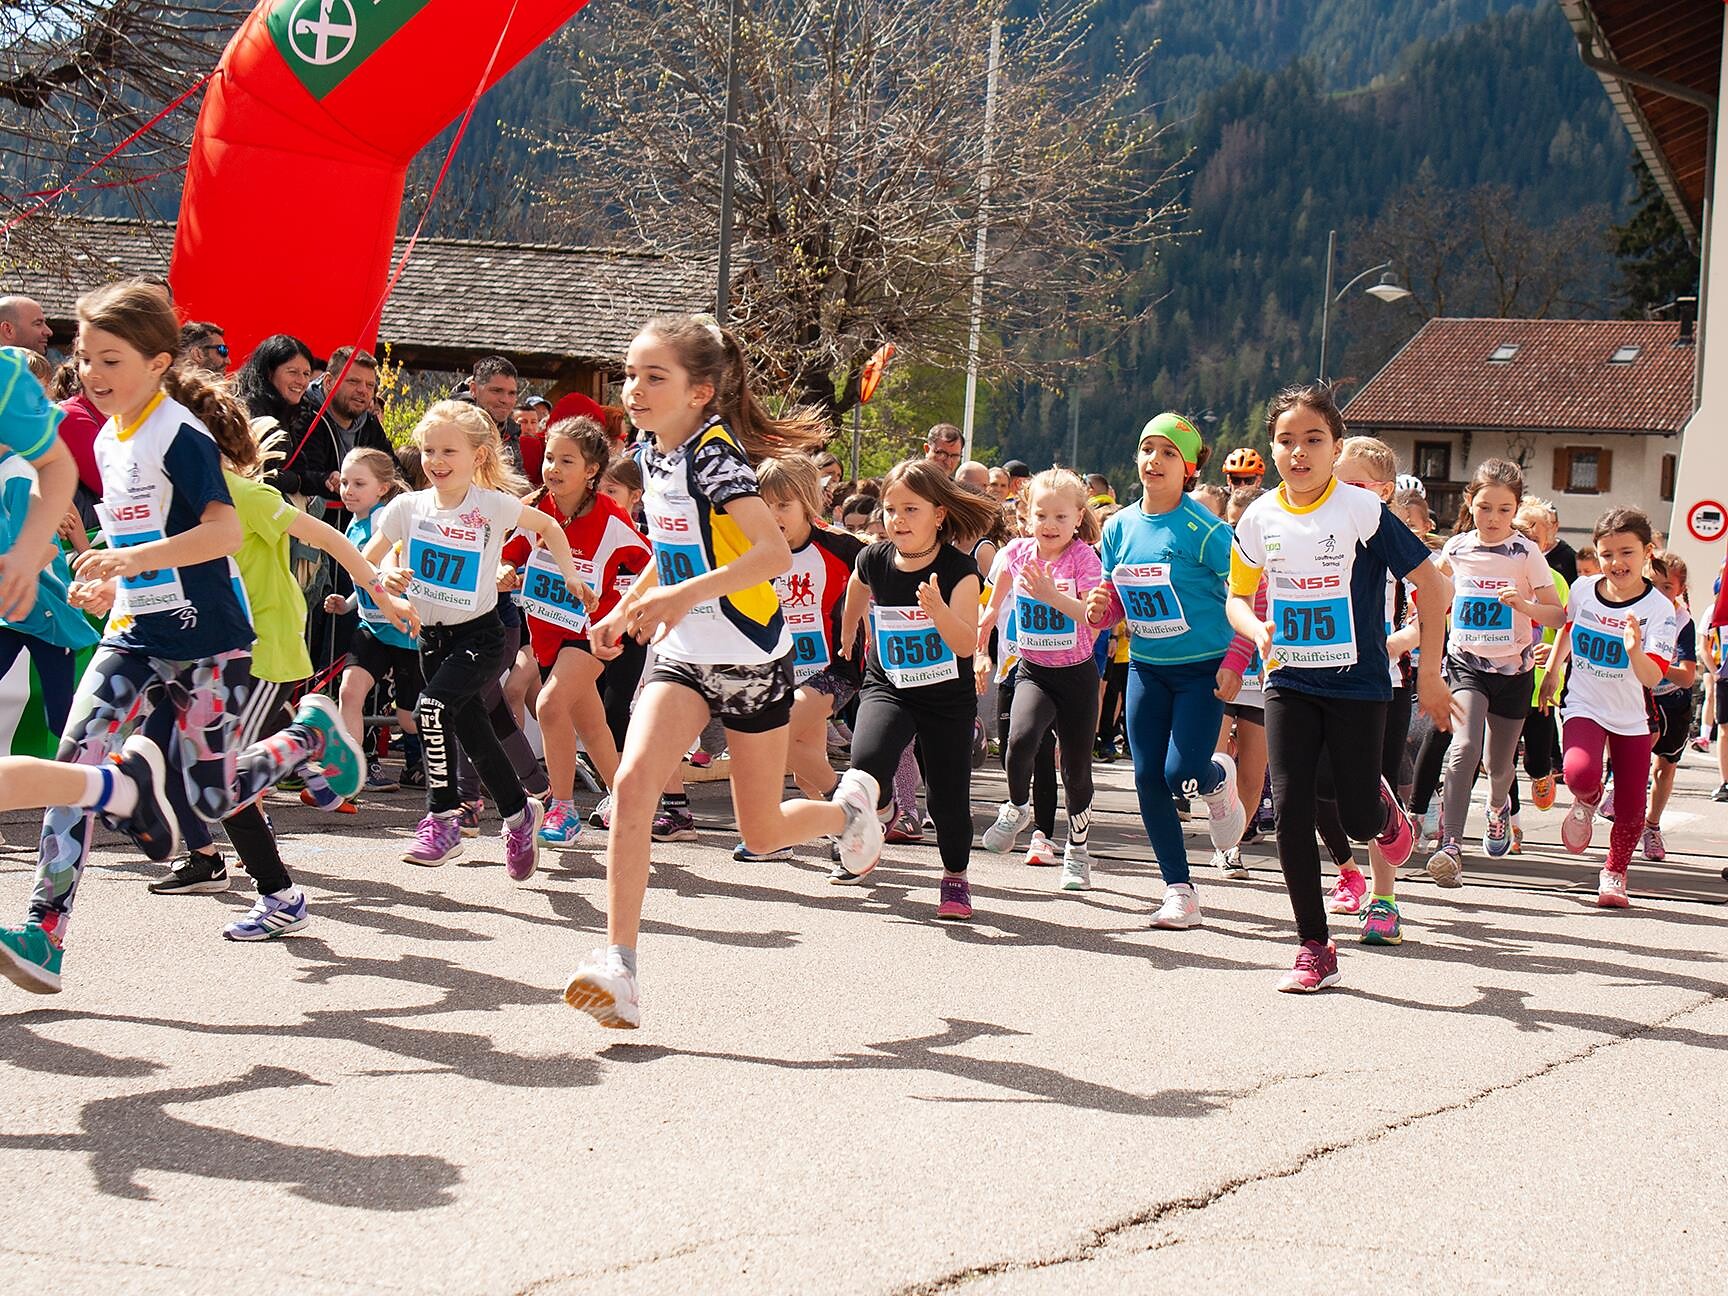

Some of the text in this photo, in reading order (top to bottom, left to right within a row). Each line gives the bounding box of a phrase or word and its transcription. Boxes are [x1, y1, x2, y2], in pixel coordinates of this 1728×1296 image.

[436, 524, 477, 541] VSS
[421, 548, 466, 585] 677
[1127, 566, 1163, 577] VSS
[1290, 575, 1340, 590] VSS
[423, 586, 472, 606] Raiffeisen
[1126, 590, 1169, 617] 531
[537, 606, 580, 628] Raiffeisen
[784, 612, 815, 625] SS
[899, 610, 929, 621] VS
[1021, 601, 1065, 631] 388
[1283, 606, 1336, 641] 675
[1459, 601, 1503, 627] 482
[1142, 624, 1184, 634] Raiffeisen
[887, 633, 943, 665] 658
[1026, 637, 1073, 647] Raiffeisen
[1577, 632, 1622, 665] 609
[1291, 650, 1351, 662] Raiffeisen
[900, 667, 953, 683] Raiffeisen
[423, 734, 448, 788] PUMA
